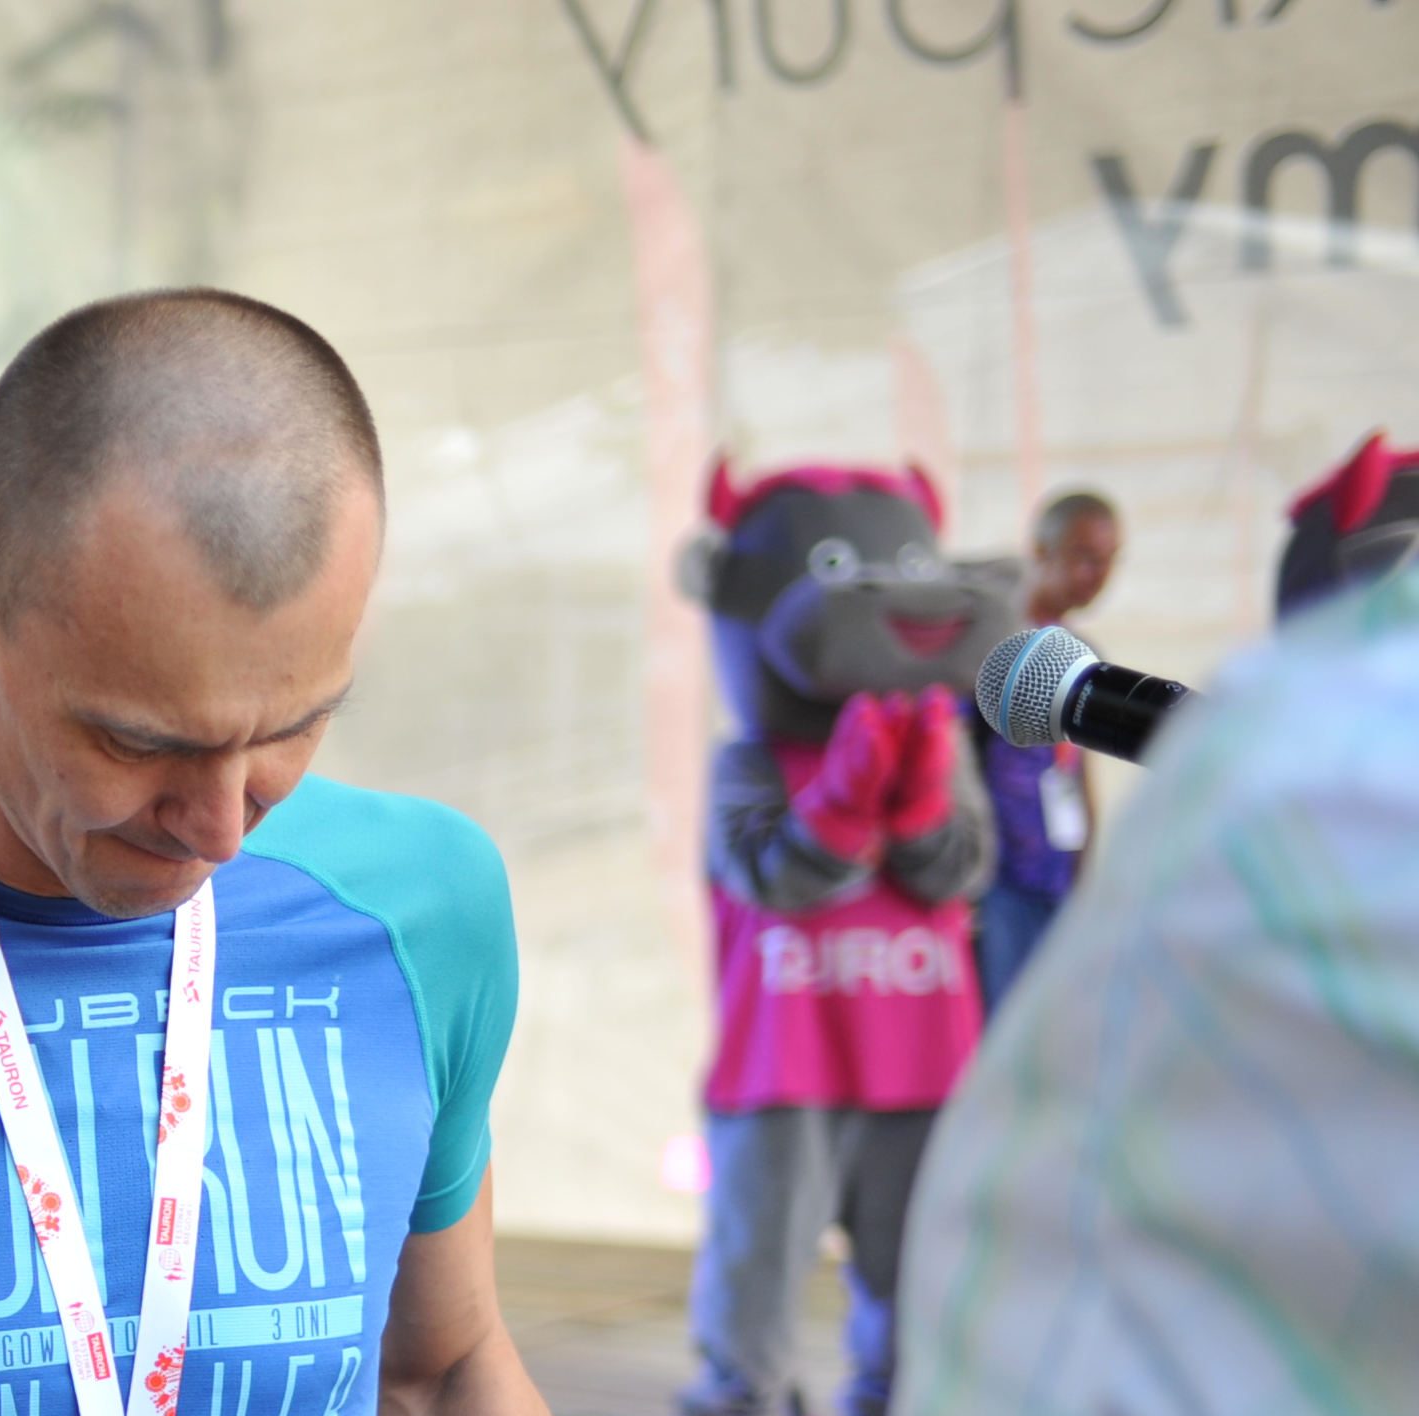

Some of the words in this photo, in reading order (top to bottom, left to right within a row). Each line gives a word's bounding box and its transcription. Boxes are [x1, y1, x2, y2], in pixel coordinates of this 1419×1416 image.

[187, 896, 203, 974] TAURON
[159, 1199, 174, 1243] TAURON
[272, 1308, 281, 1341] 3
[296, 1304, 329, 1338] DNI
[90, 1334, 107, 1378] TAURON
